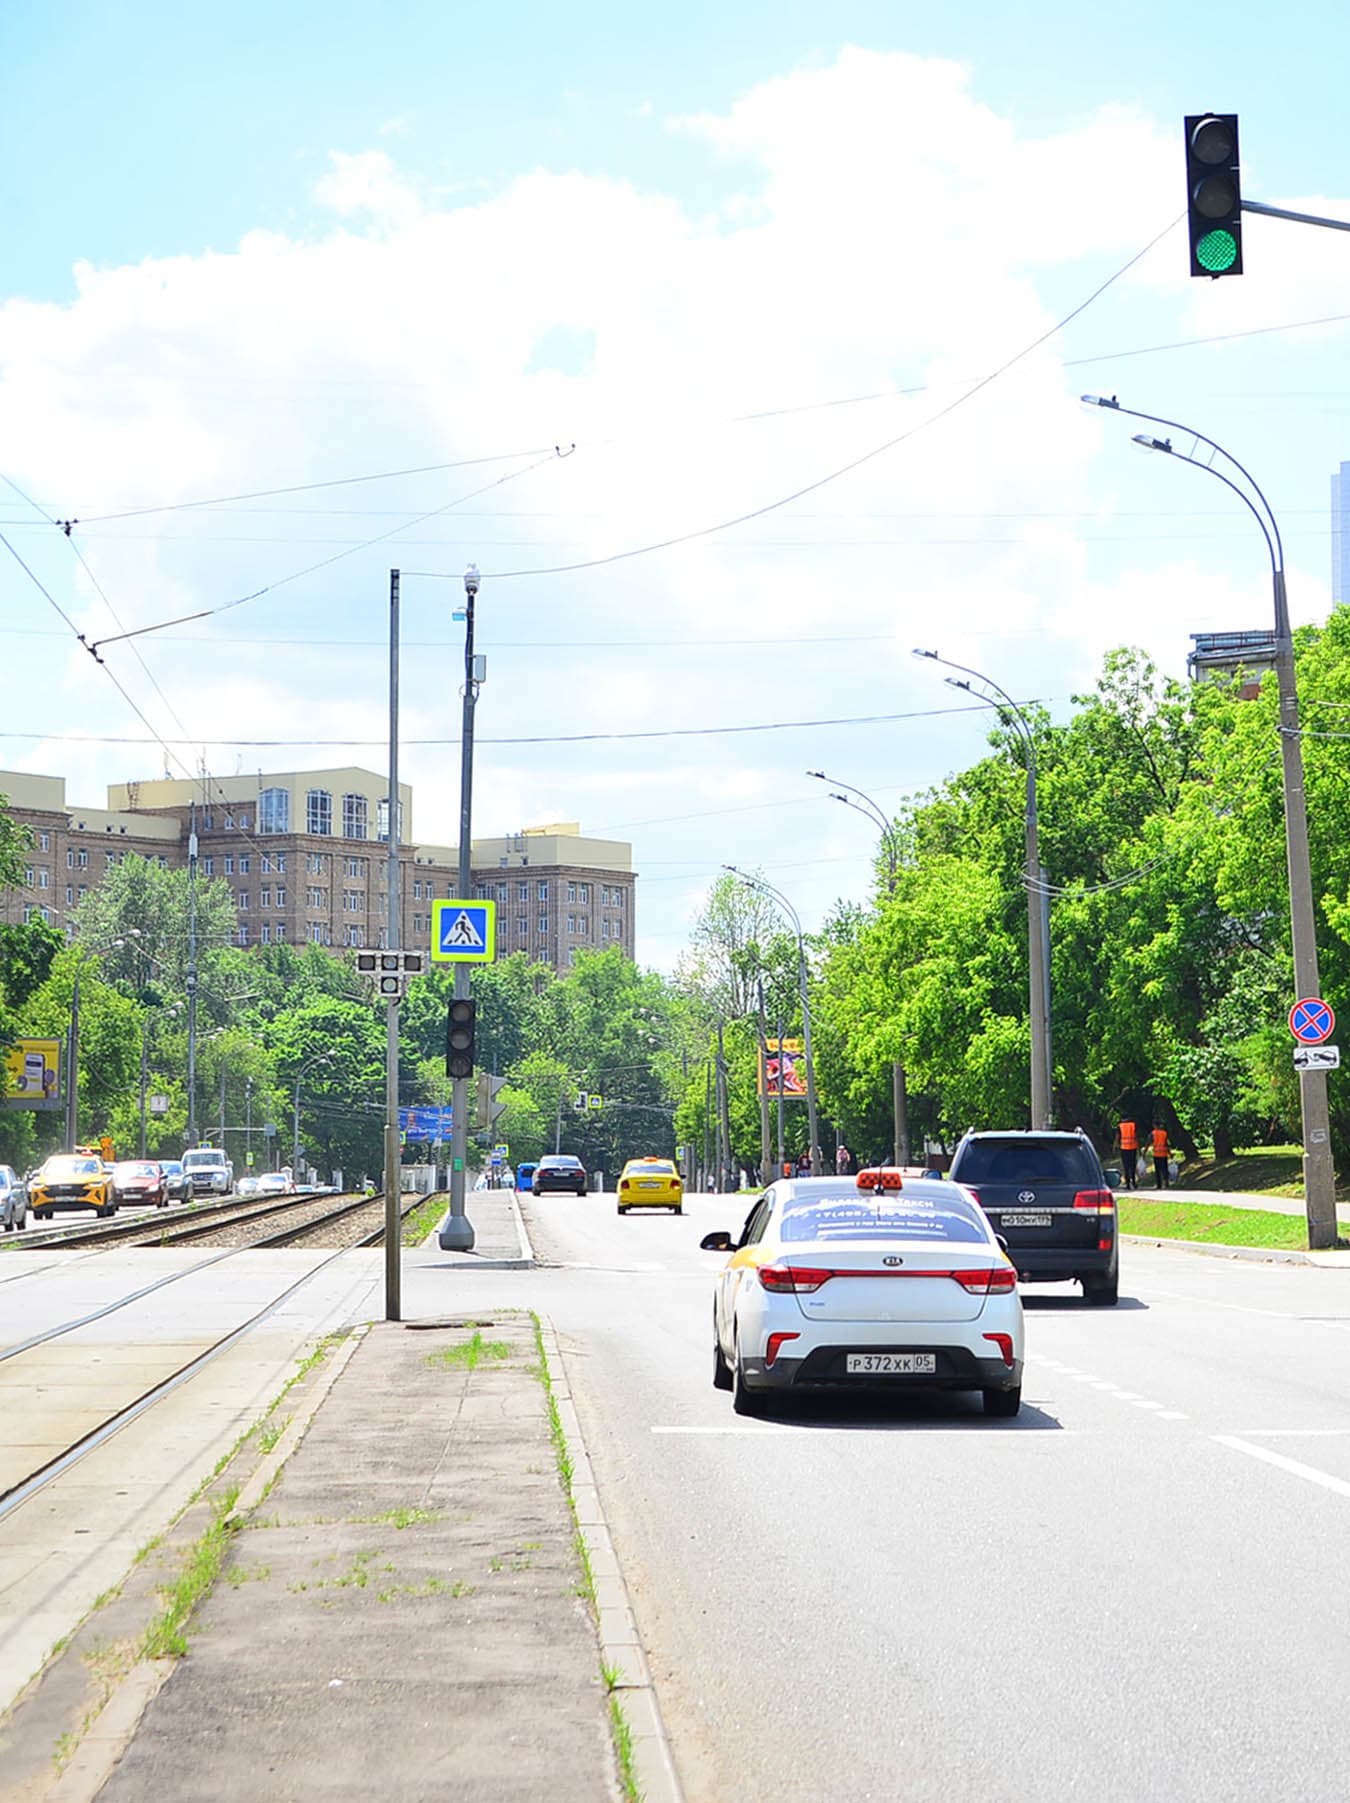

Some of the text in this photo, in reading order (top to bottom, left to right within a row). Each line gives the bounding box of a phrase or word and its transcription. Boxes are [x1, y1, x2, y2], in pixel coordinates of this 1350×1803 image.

[884, 1256, 902, 1266] KIA
[853, 1355, 930, 1371] Р372ХК 05
